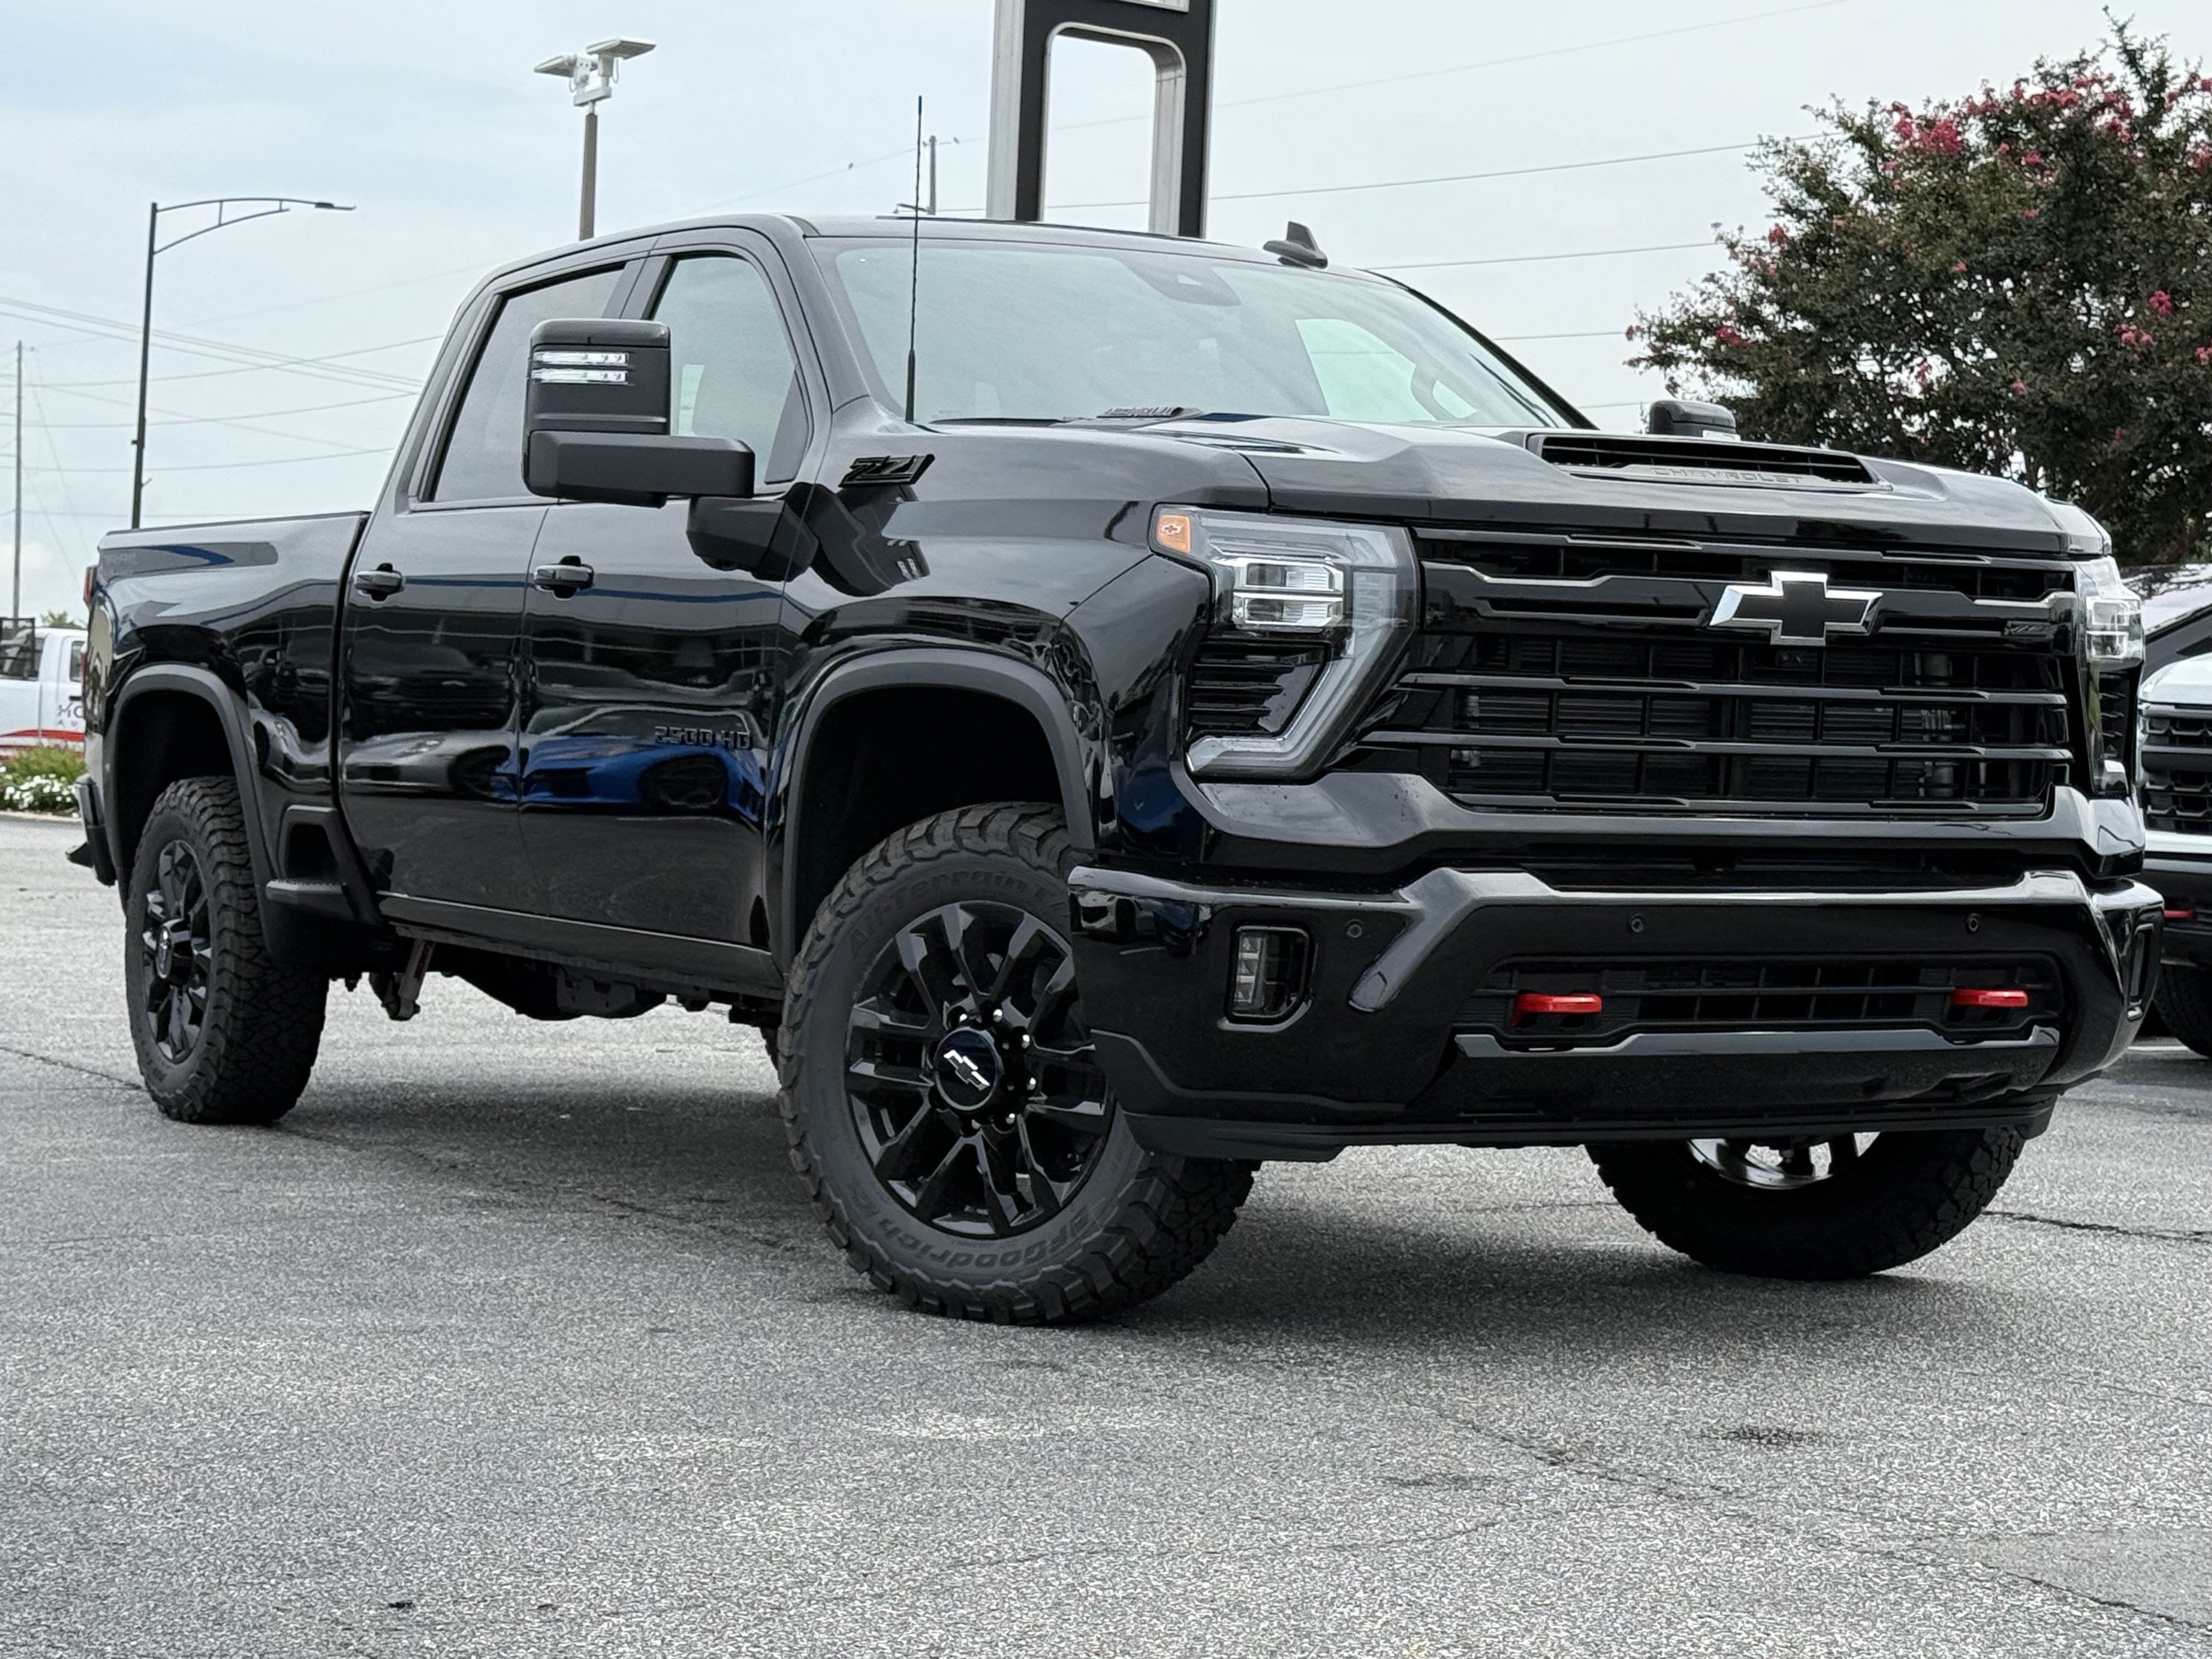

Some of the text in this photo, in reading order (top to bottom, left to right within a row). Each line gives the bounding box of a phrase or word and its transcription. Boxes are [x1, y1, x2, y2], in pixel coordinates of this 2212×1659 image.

[1651, 467, 1802, 484] CHEVROLET
[654, 726, 751, 749] 2500 HD
[877, 1206, 1092, 1269] BFGoodrich
